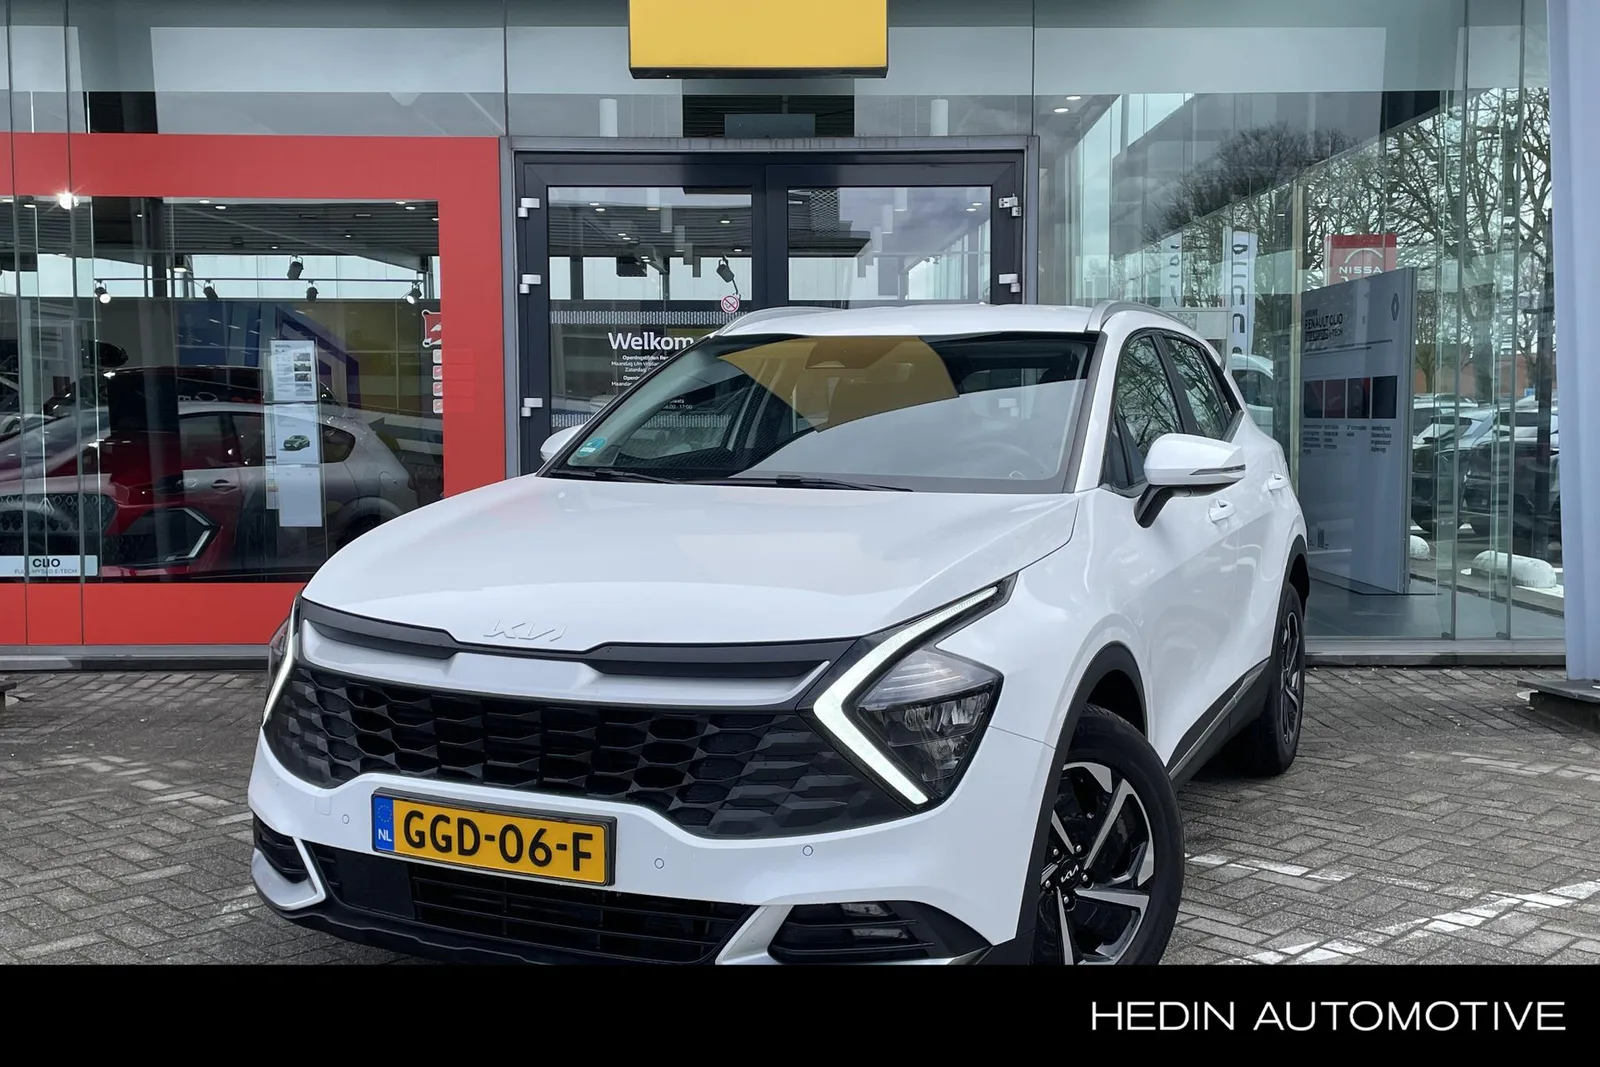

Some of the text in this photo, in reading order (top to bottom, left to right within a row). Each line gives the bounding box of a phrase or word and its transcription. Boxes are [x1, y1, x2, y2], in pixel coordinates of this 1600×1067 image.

[1339, 266, 1383, 274] NISSA
[1329, 313, 1343, 327] CLIO
[608, 331, 694, 350] Welkom
[32, 558, 60, 567] CLIO
[378, 828, 392, 843] NL
[403, 809, 593, 872] GGD-06-F
